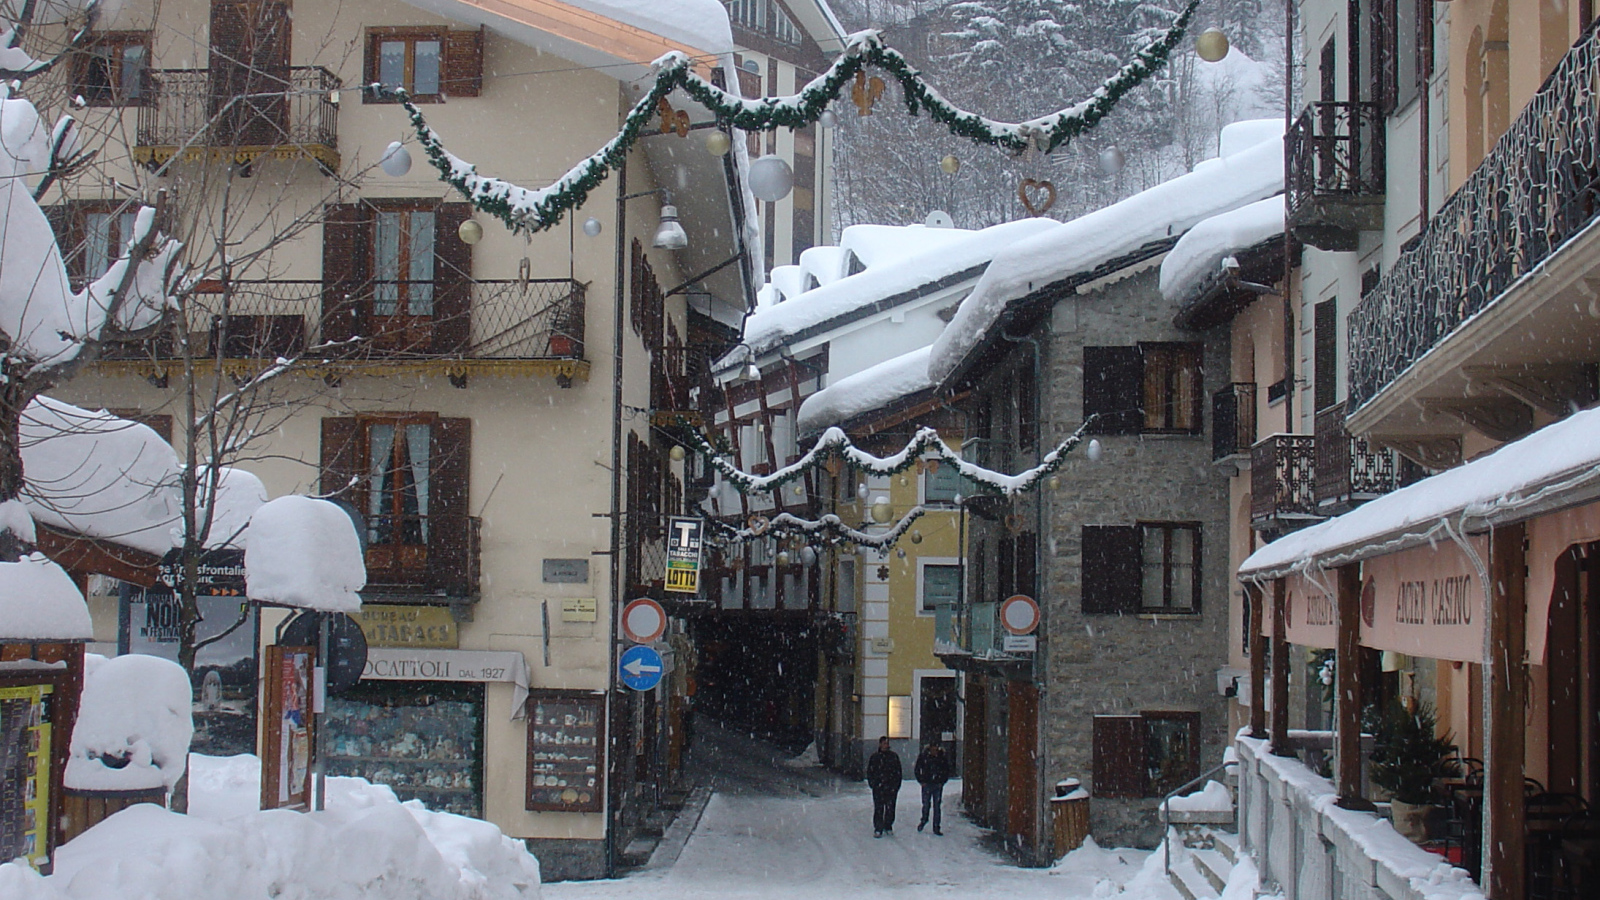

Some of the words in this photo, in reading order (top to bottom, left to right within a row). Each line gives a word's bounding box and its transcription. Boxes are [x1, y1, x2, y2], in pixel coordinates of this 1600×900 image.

[675, 522, 697, 547] T
[667, 569, 696, 586] LOTTO
[1396, 581, 1426, 624] ANCIEN
[1432, 574, 1472, 625] CASINO
[377, 624, 449, 642] TABACS
[459, 669, 476, 678] DAL
[480, 668, 505, 679] 1927
